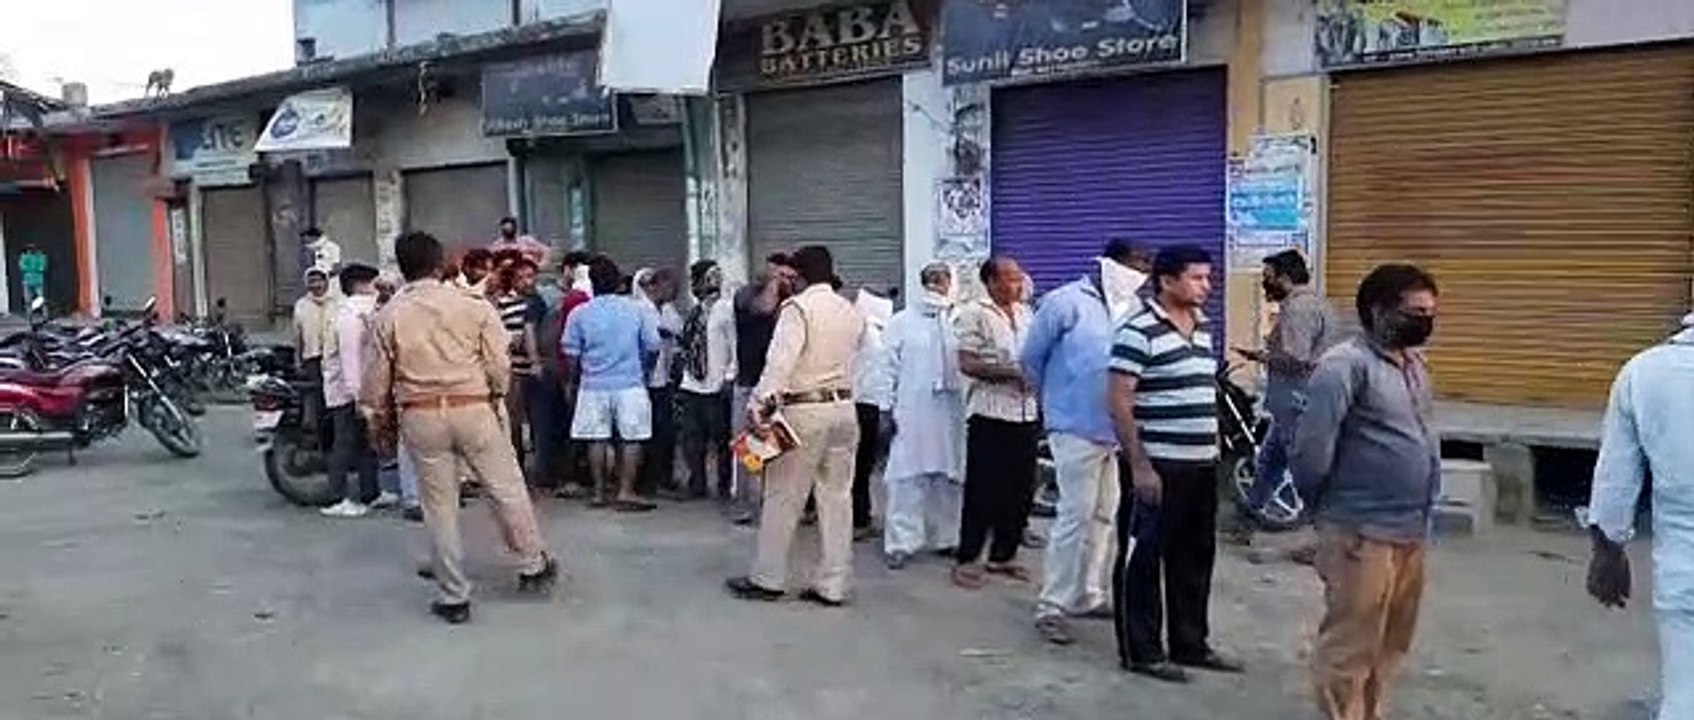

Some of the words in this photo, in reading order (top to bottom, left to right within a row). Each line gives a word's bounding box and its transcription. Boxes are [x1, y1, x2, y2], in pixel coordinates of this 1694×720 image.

[762, 2, 919, 54] BABA
[762, 37, 921, 73] BATTERIES
[947, 51, 1009, 75] Sunil
[1018, 46, 1088, 66] Shoe
[1098, 34, 1178, 57] Store
